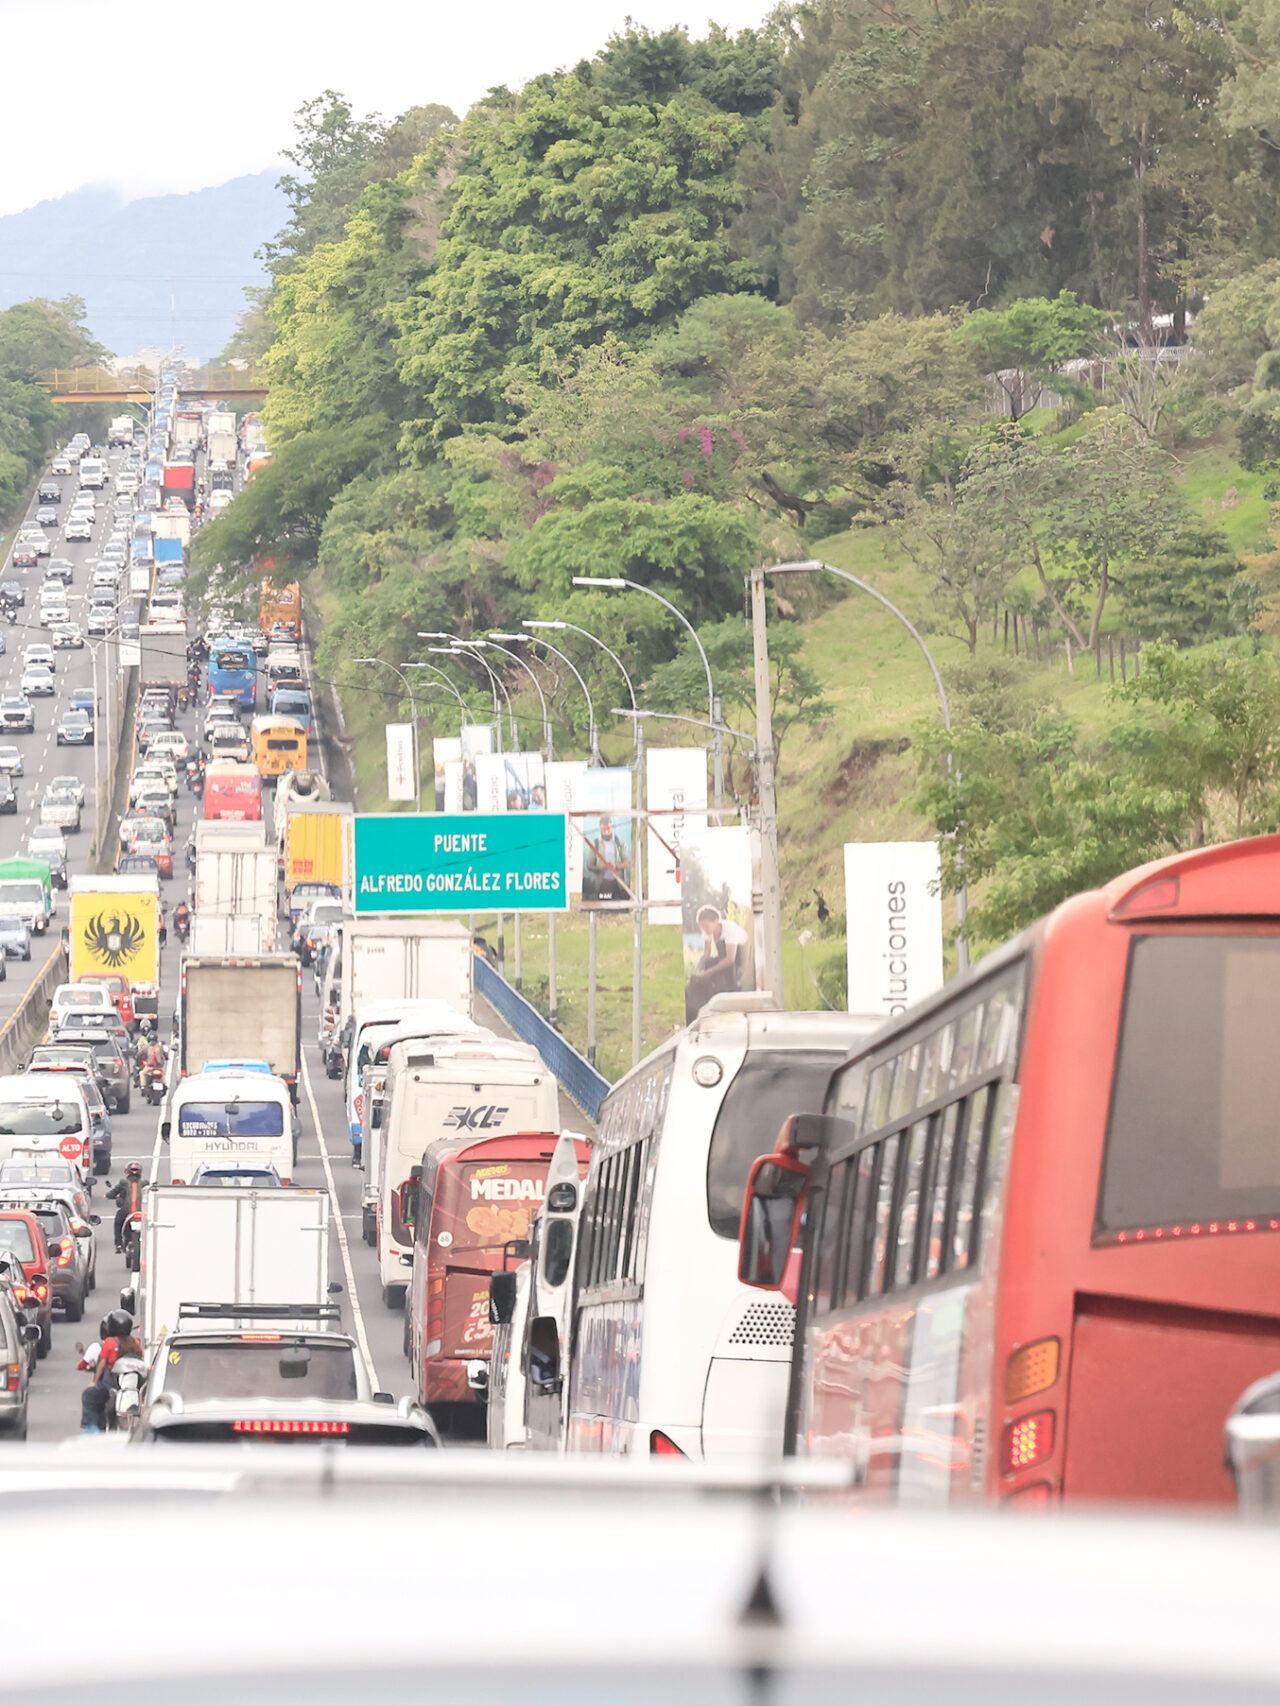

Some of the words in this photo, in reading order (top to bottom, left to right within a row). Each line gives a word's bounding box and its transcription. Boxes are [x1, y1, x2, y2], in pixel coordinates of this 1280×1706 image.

[433, 833, 487, 853] PUENTE
[360, 873, 423, 894] ALFREDO
[426, 866, 501, 893] GONZÁLEZ
[505, 872, 560, 891] FLORES
[61, 1144, 81, 1152] ALTO
[205, 1141, 258, 1151] HYUNDAI
[470, 1179, 546, 1201] MEDAL
